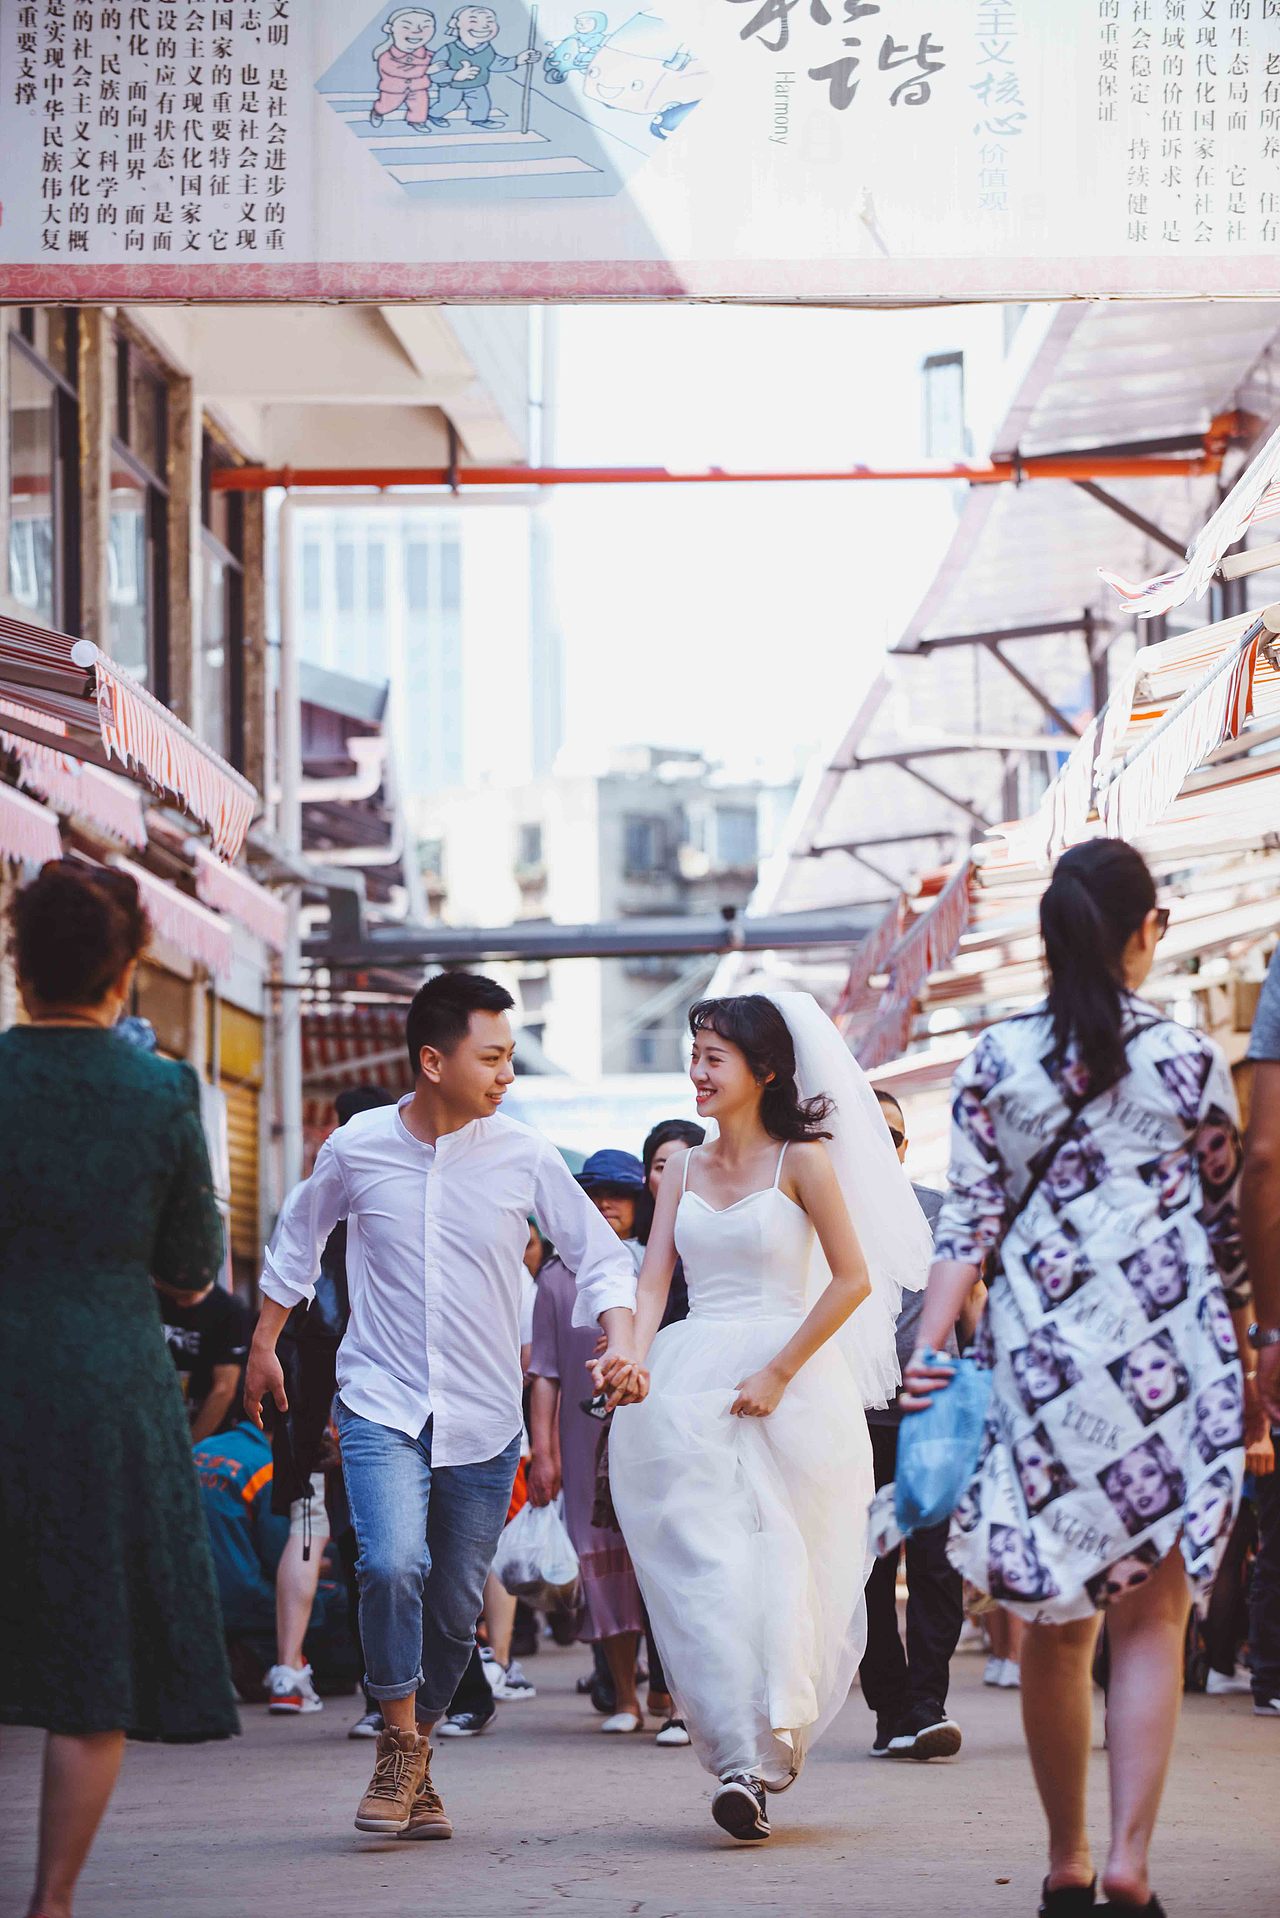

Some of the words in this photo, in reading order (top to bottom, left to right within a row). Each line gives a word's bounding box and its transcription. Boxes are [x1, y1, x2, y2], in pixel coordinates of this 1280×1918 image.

[14, 0, 38, 117] 重要支撑。
[68, 0, 93, 252] 的社会主义文化的概
[96, 0, 122, 237] 的，民族的、科学的、
[124, 0, 150, 251] 代化、面向世界、面向
[152, 0, 178, 251] 设的应有状态，是面
[180, 0, 205, 251] 会主义现代化国家文
[207, 0, 234, 250] 国家的重要特征。它
[235, 0, 261, 250] 志，也是社会主义现
[768, 71, 796, 145] Harmony
